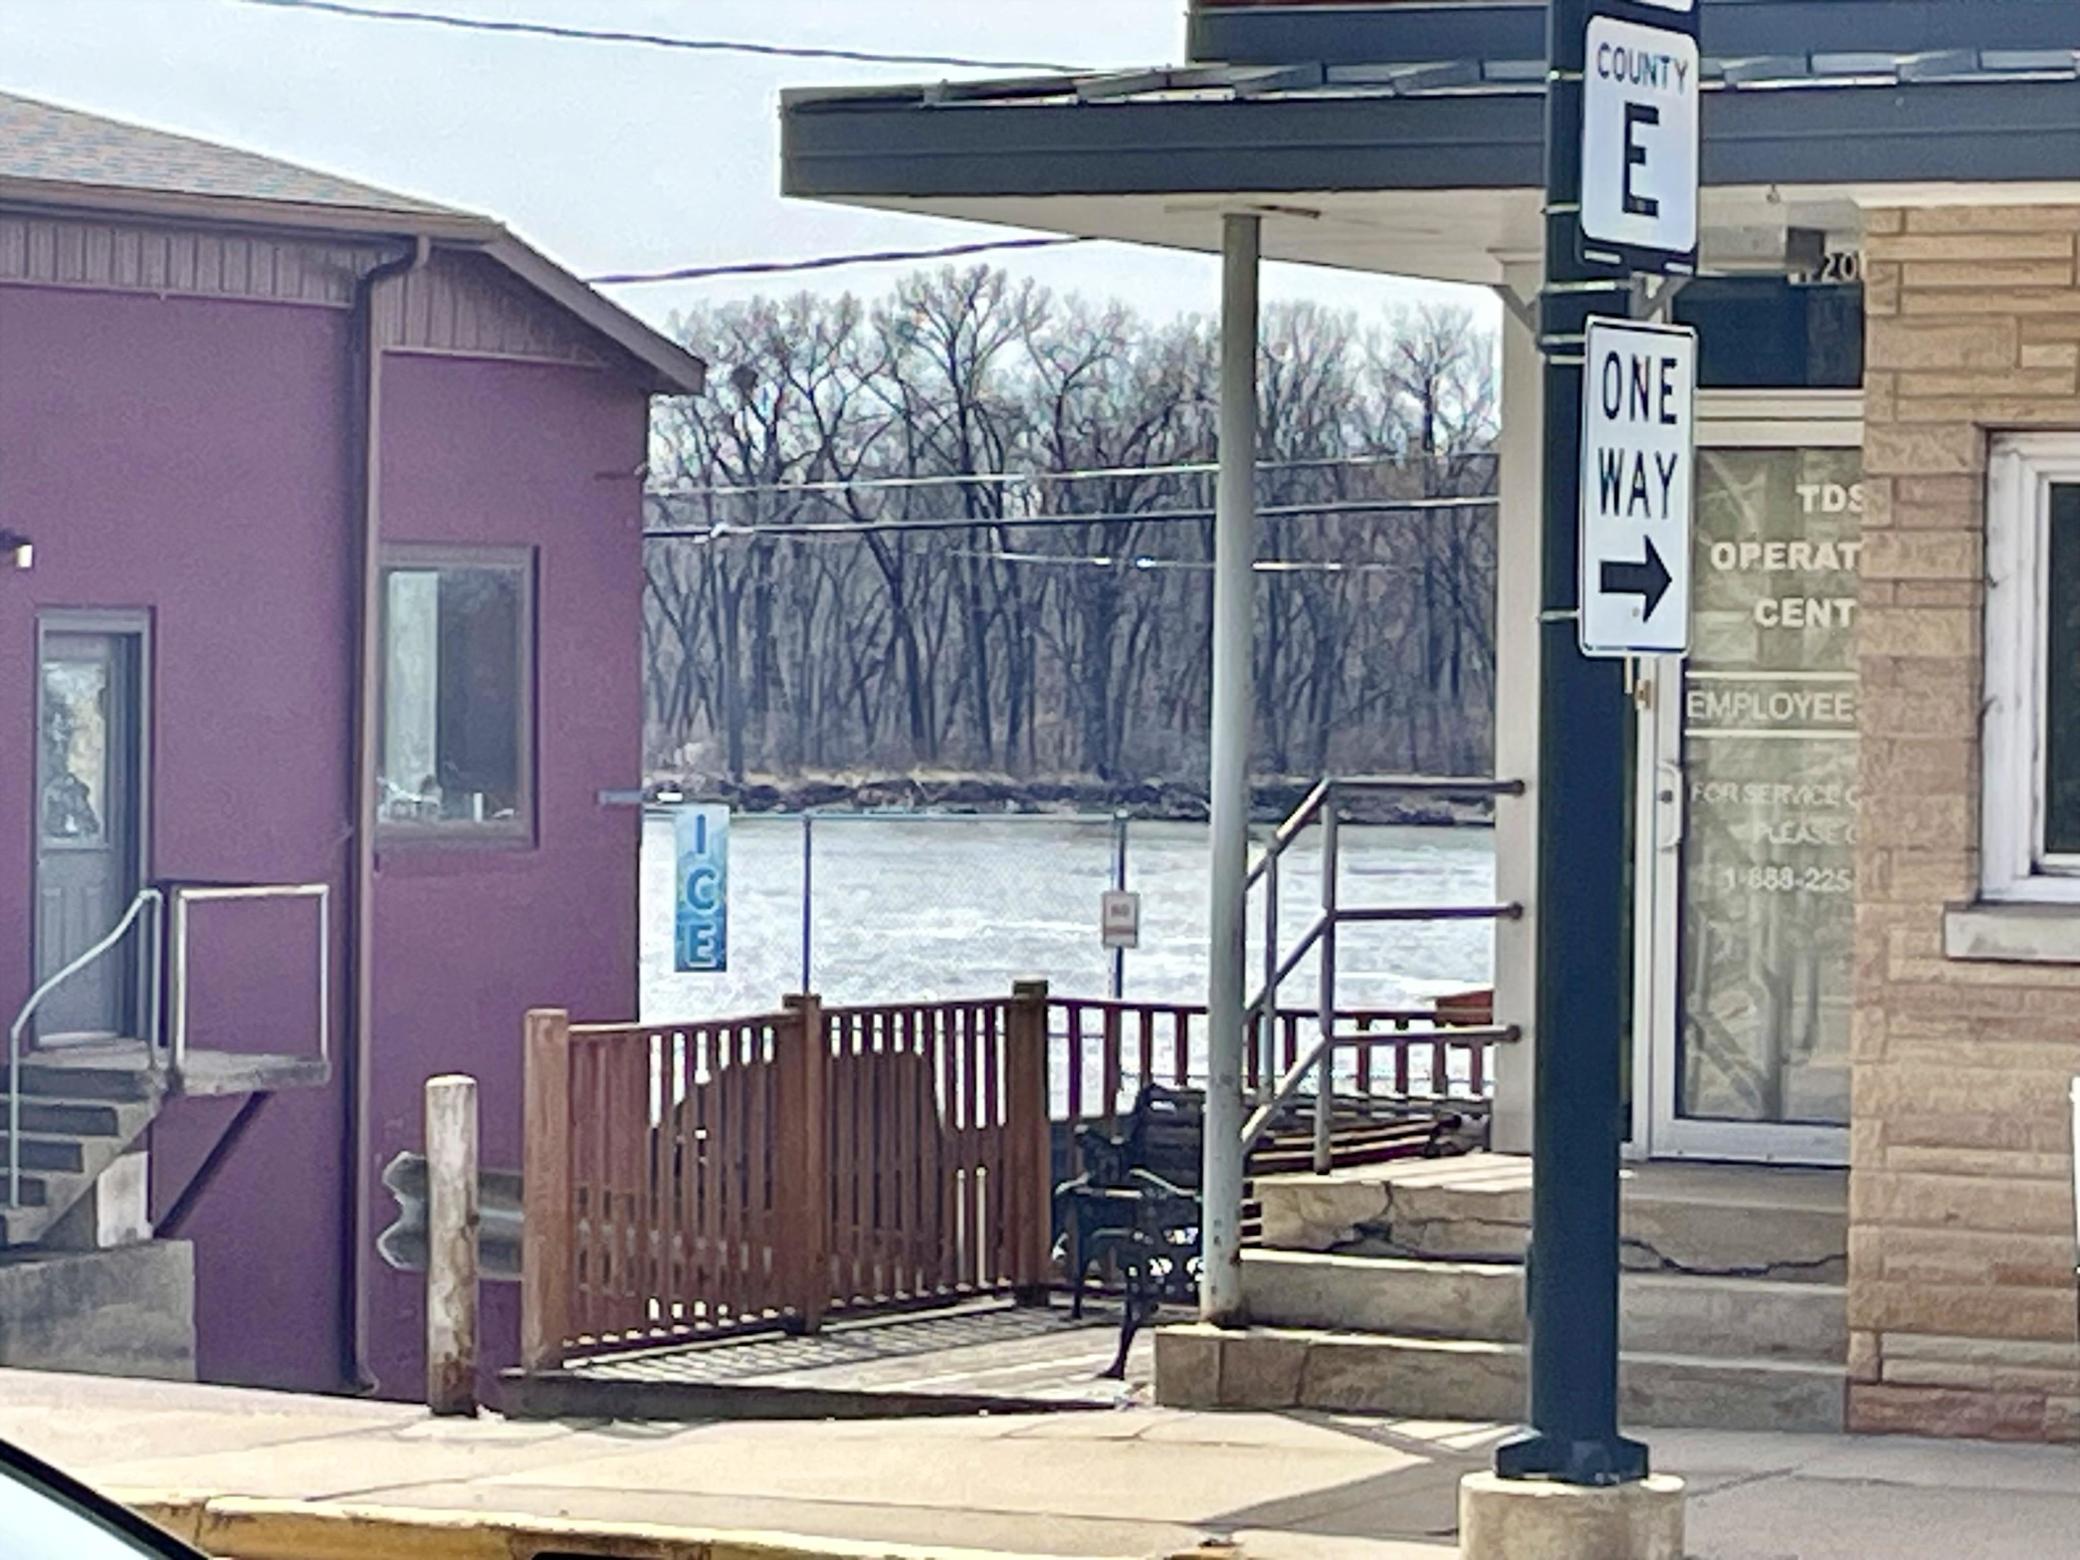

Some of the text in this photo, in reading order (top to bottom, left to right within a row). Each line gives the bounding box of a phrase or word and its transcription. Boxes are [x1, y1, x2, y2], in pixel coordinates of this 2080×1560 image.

[1597, 42, 1689, 95] COUNTY
[1622, 100, 1660, 219] E
[1602, 350, 1678, 424] ONE
[1598, 447, 1678, 520] WAY
[1796, 484, 1863, 514] TDS
[1710, 541, 1862, 571] OPERAT
[1754, 597, 1857, 628] CENT
[1686, 690, 1855, 721] EMPLOYEE
[1690, 782, 1738, 803] FOR
[1742, 783, 1841, 805] SERVICE
[686, 813, 719, 968] ICE
